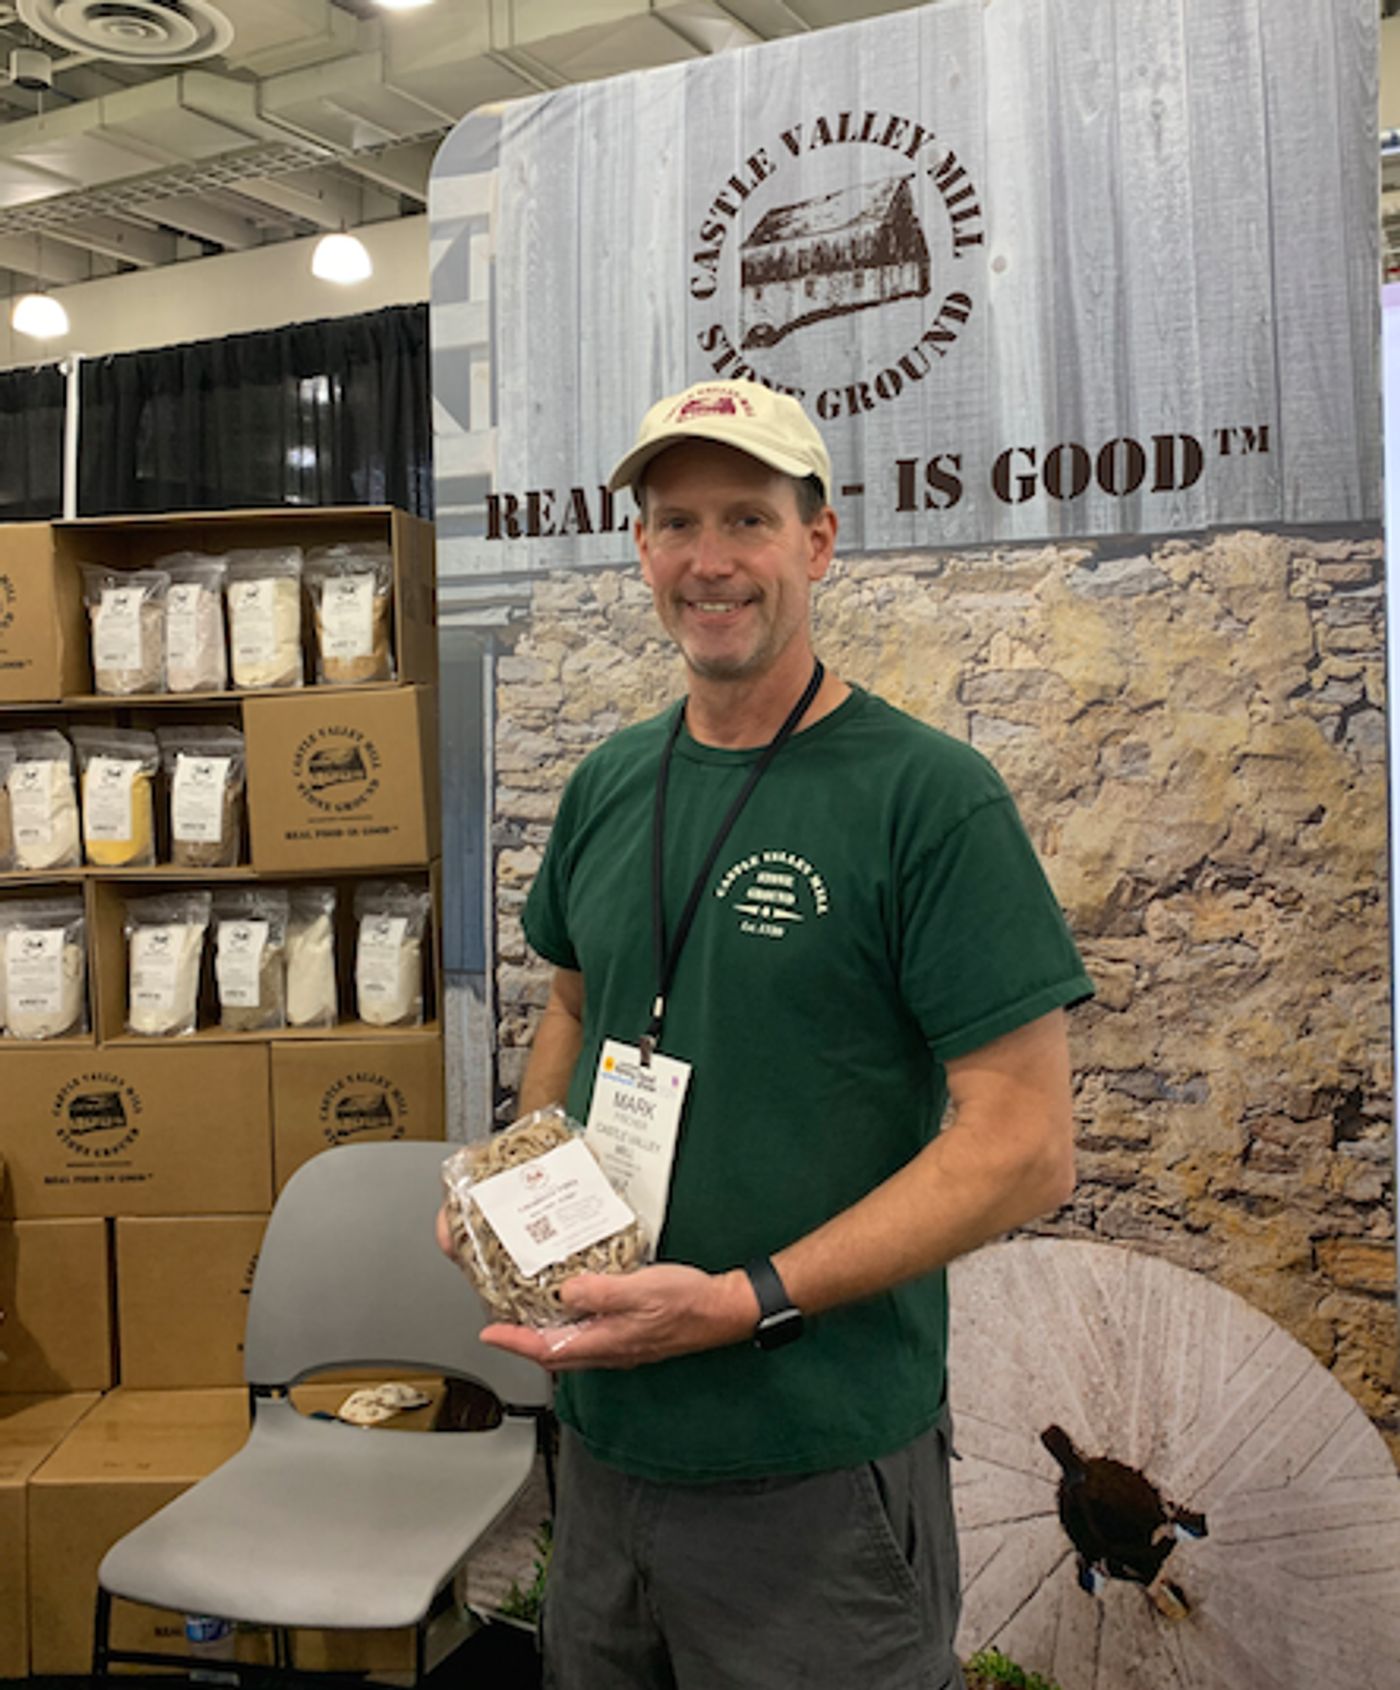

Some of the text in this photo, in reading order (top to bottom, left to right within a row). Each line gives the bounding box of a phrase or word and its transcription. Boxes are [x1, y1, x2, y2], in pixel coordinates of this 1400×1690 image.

[690, 111, 984, 300] CASTLE VALLEY MILL
[816, 292, 973, 420] GROUND
[485, 485, 629, 541] REAL
[895, 453, 963, 512] IS
[613, 1091, 657, 1120] MARK
